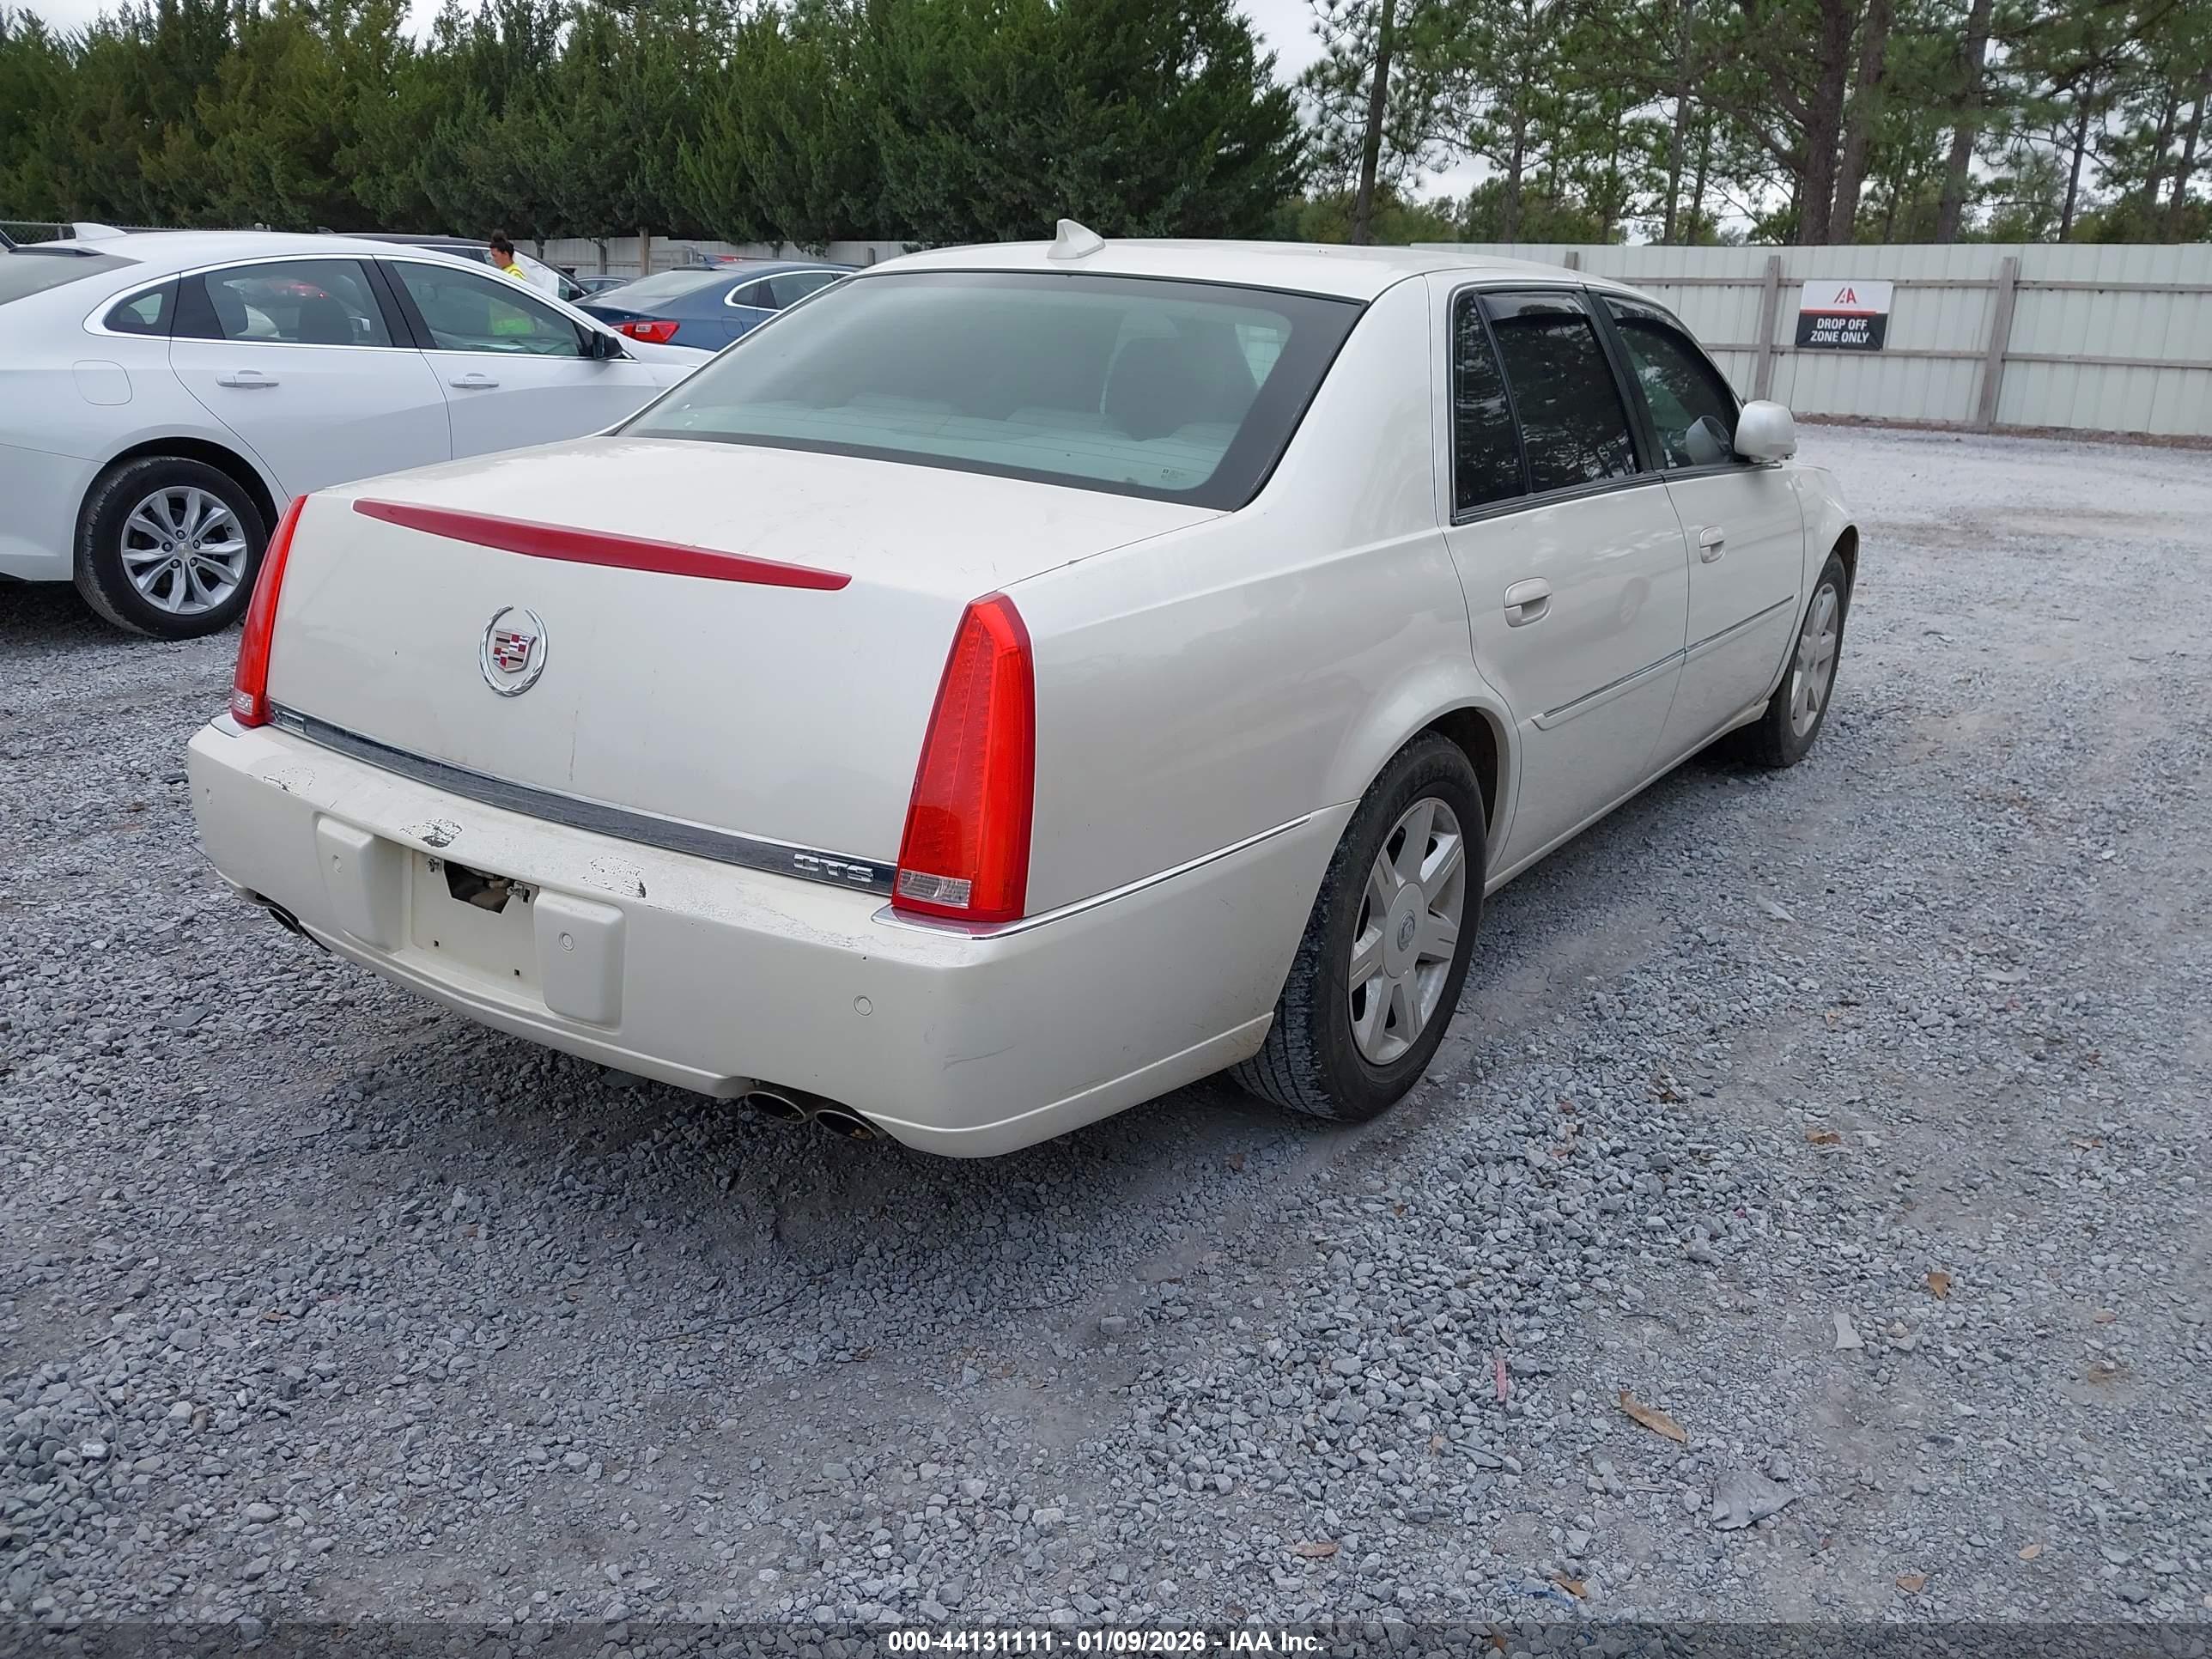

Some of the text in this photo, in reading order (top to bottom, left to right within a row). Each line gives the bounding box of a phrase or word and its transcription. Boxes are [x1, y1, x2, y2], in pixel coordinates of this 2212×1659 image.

[1816, 318, 1868, 331] DROP OFF
[1810, 331, 1869, 343] ZONE ONLY
[793, 854, 874, 883] DTS
